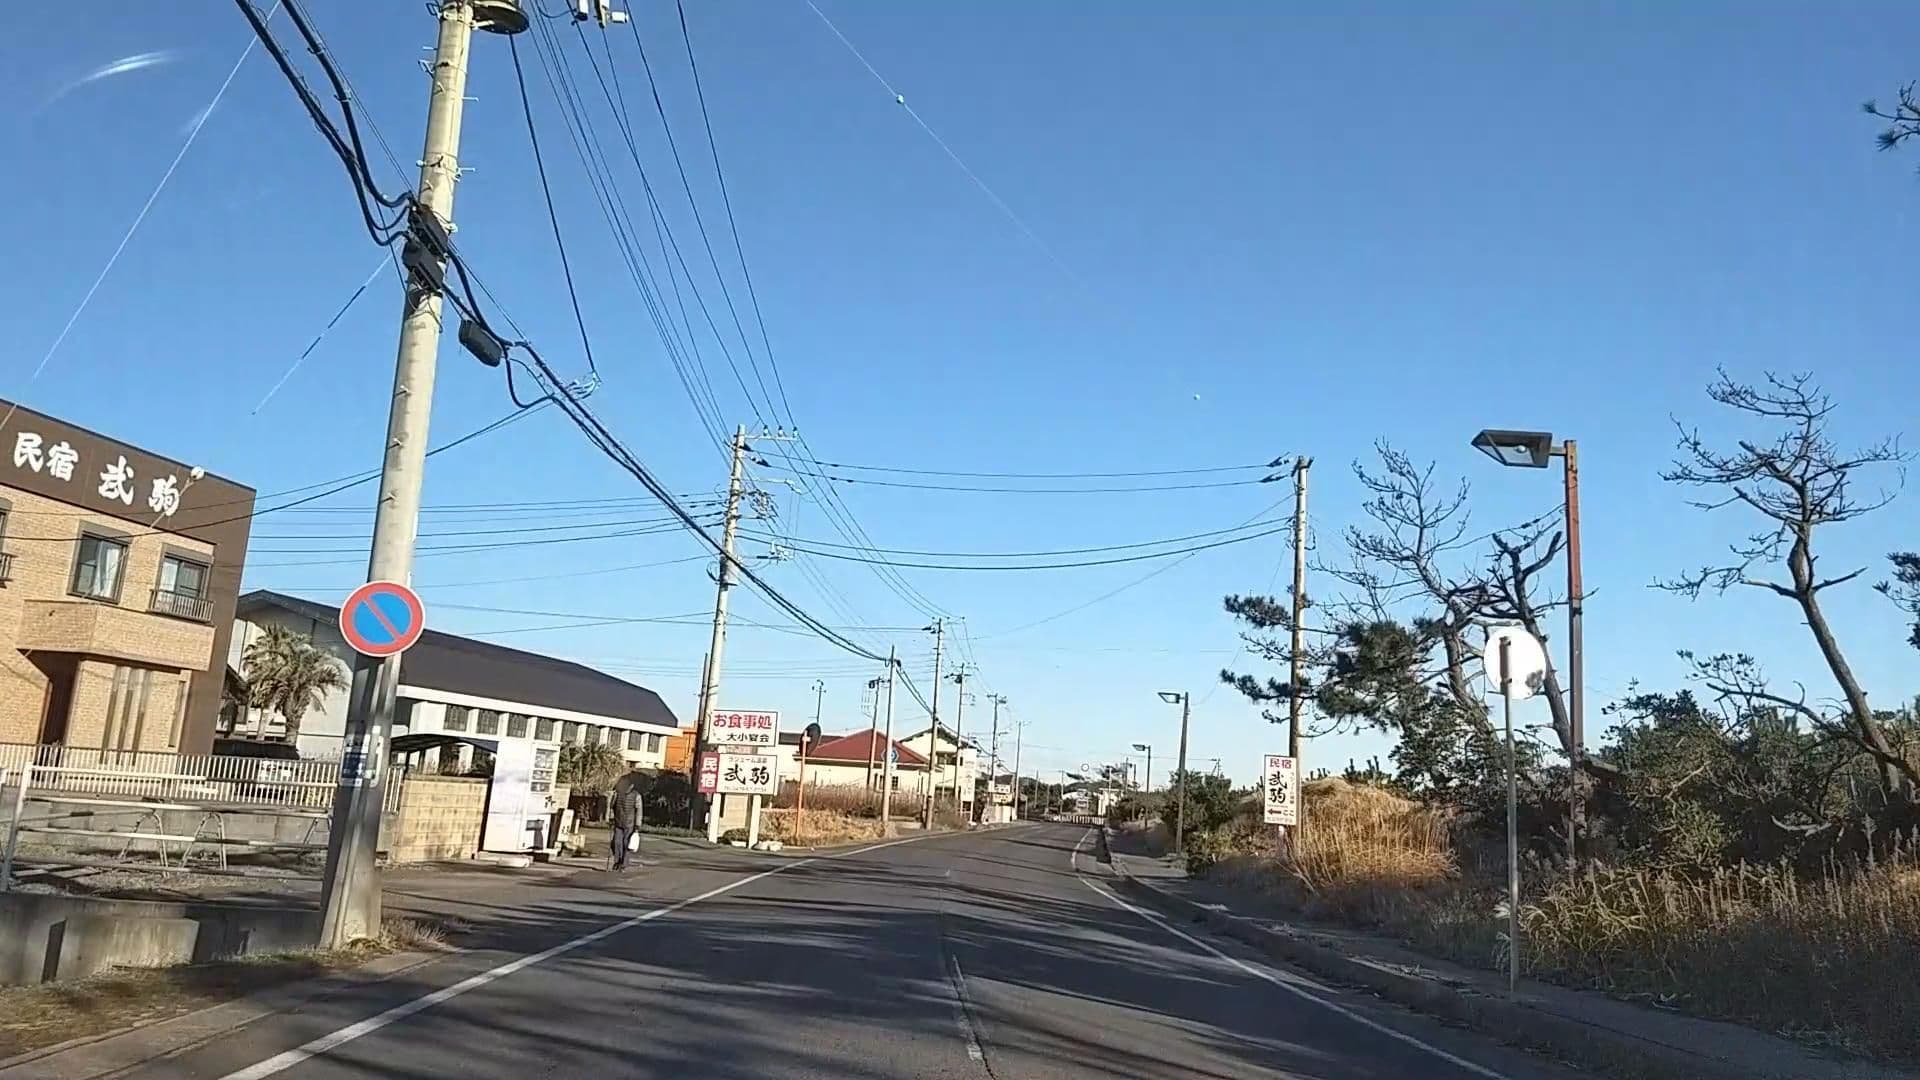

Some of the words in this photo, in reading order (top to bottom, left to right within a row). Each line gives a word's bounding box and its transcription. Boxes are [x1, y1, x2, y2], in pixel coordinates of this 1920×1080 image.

[13, 432, 79, 482] 民宿
[98, 455, 180, 516] 武駒
[714, 714, 771, 730] お食事処
[1270, 758, 1292, 769] 民宿
[724, 763, 769, 785] 武駒
